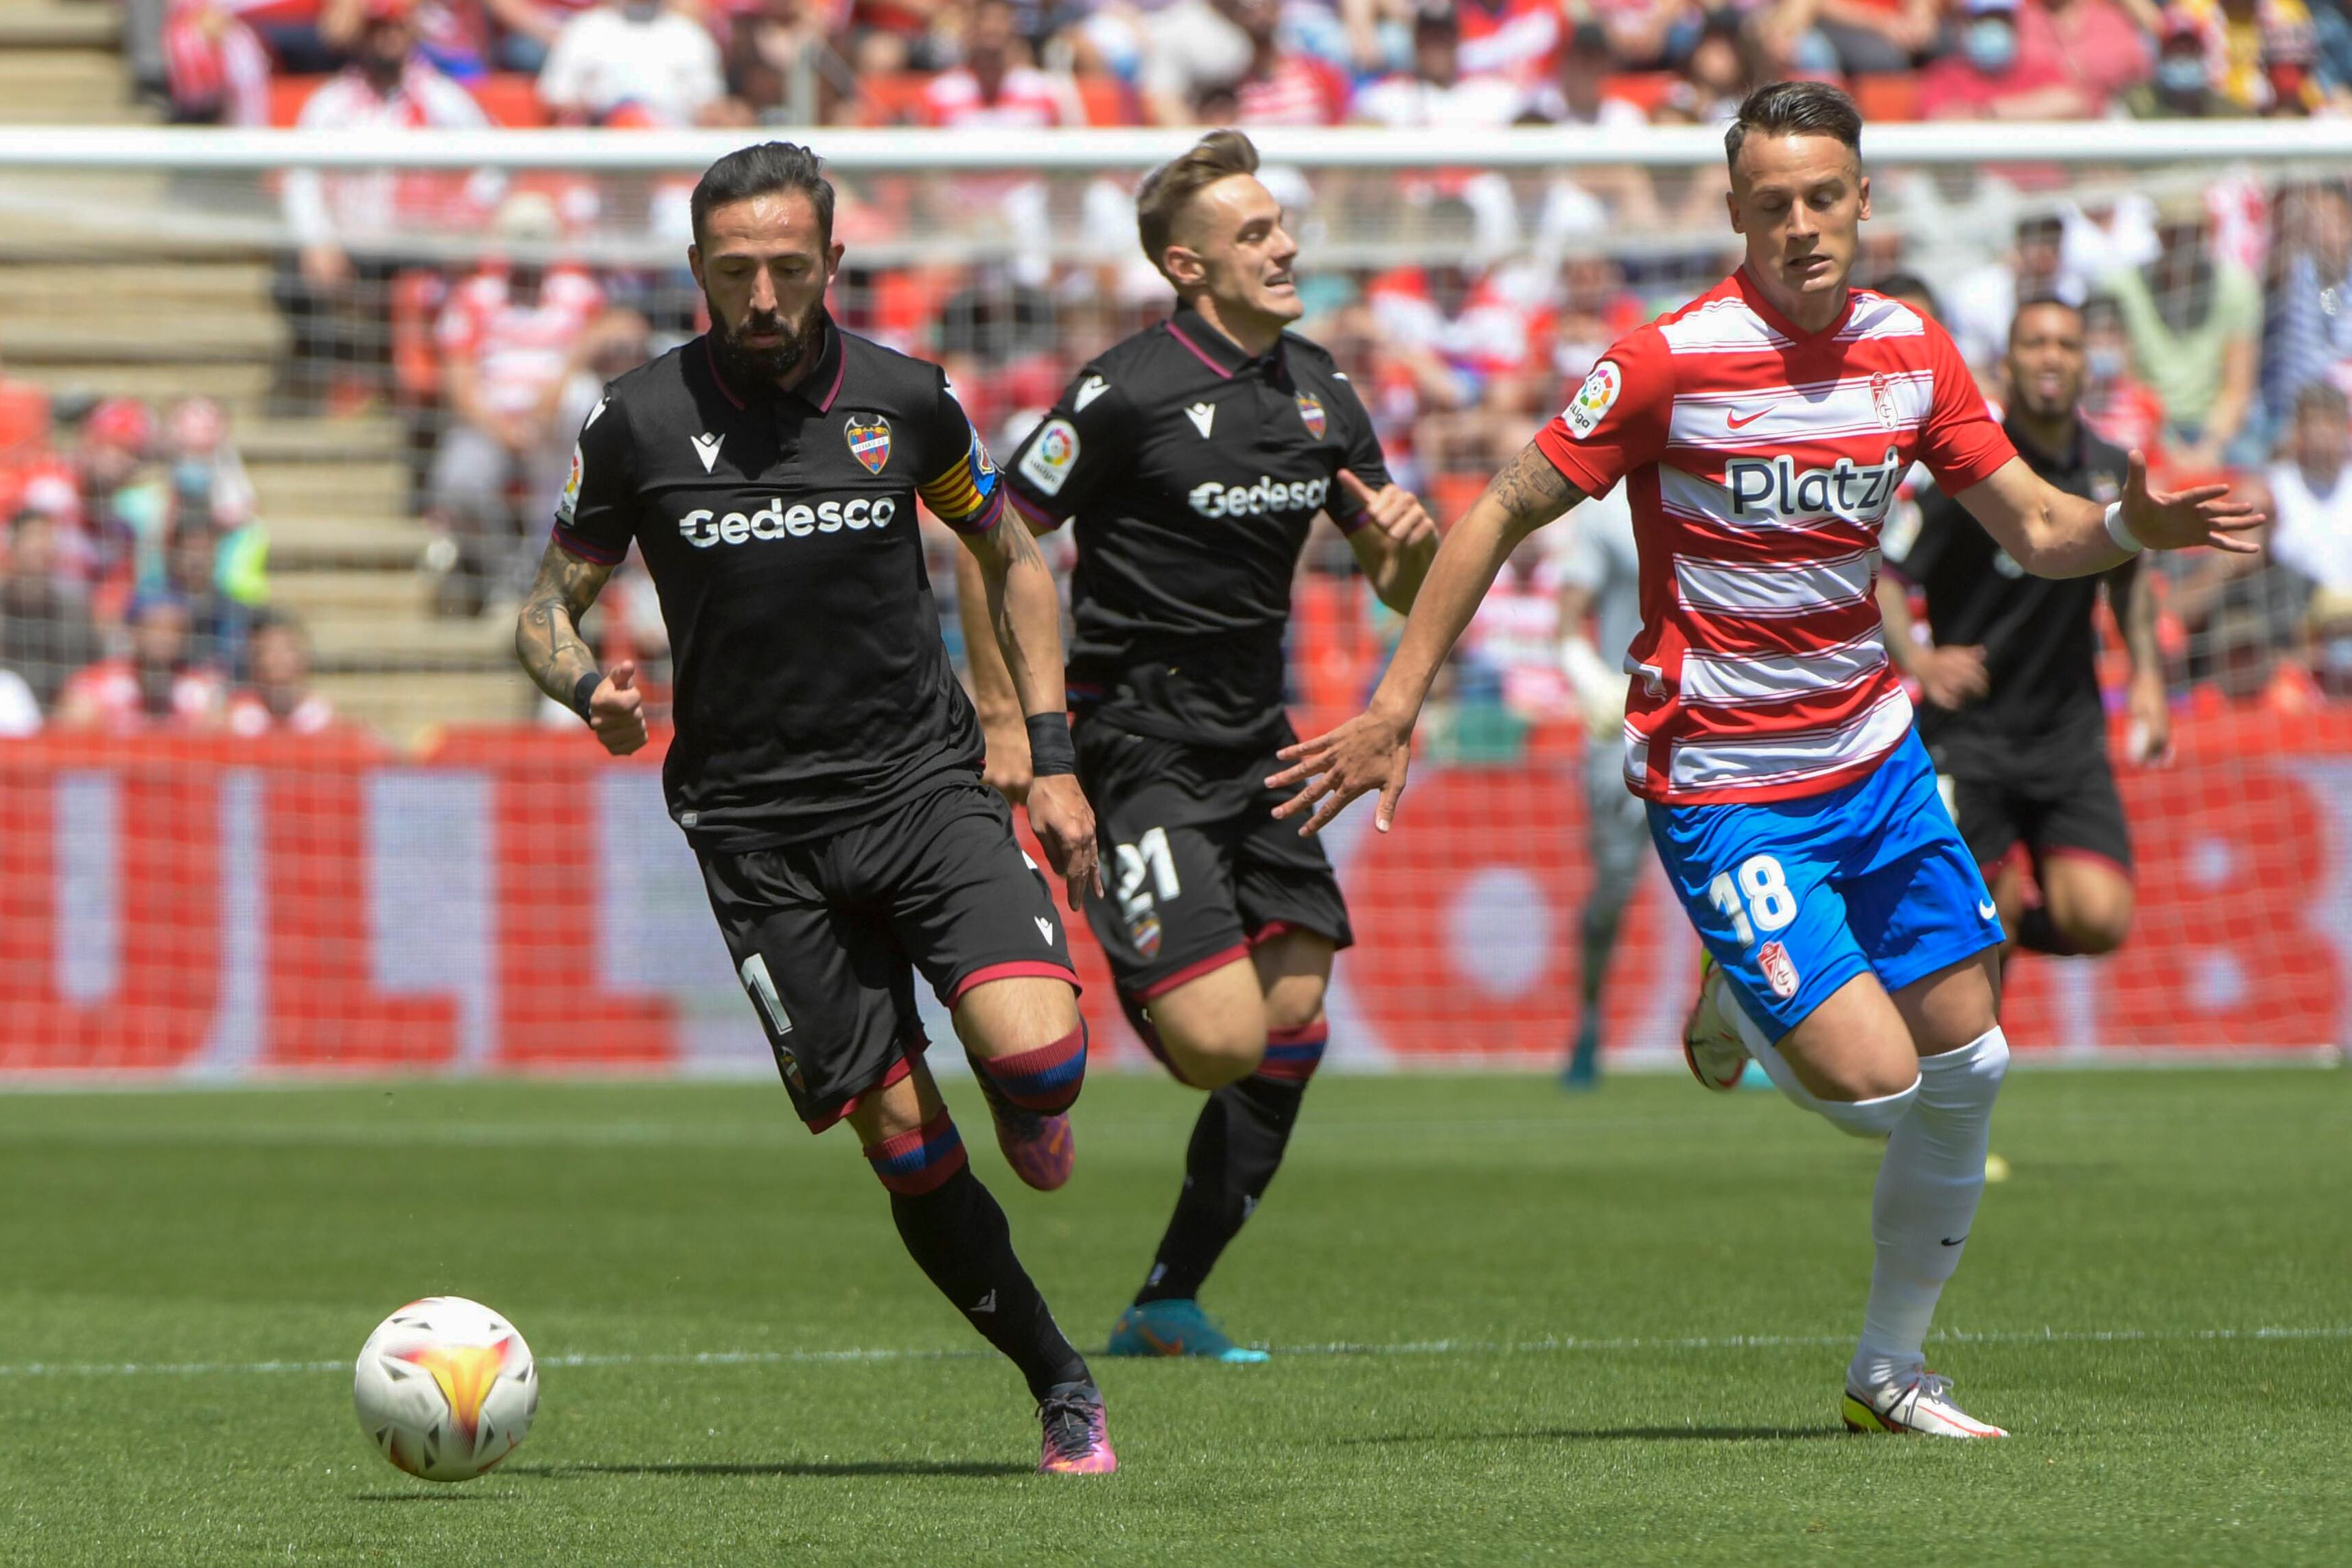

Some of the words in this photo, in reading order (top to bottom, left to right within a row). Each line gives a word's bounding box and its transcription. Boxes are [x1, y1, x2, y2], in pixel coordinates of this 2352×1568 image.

[1731, 451, 1896, 515] Platzi
[679, 498, 896, 548] Gedesco
[1114, 826, 1181, 924] 21
[1708, 855, 1797, 950] 18
